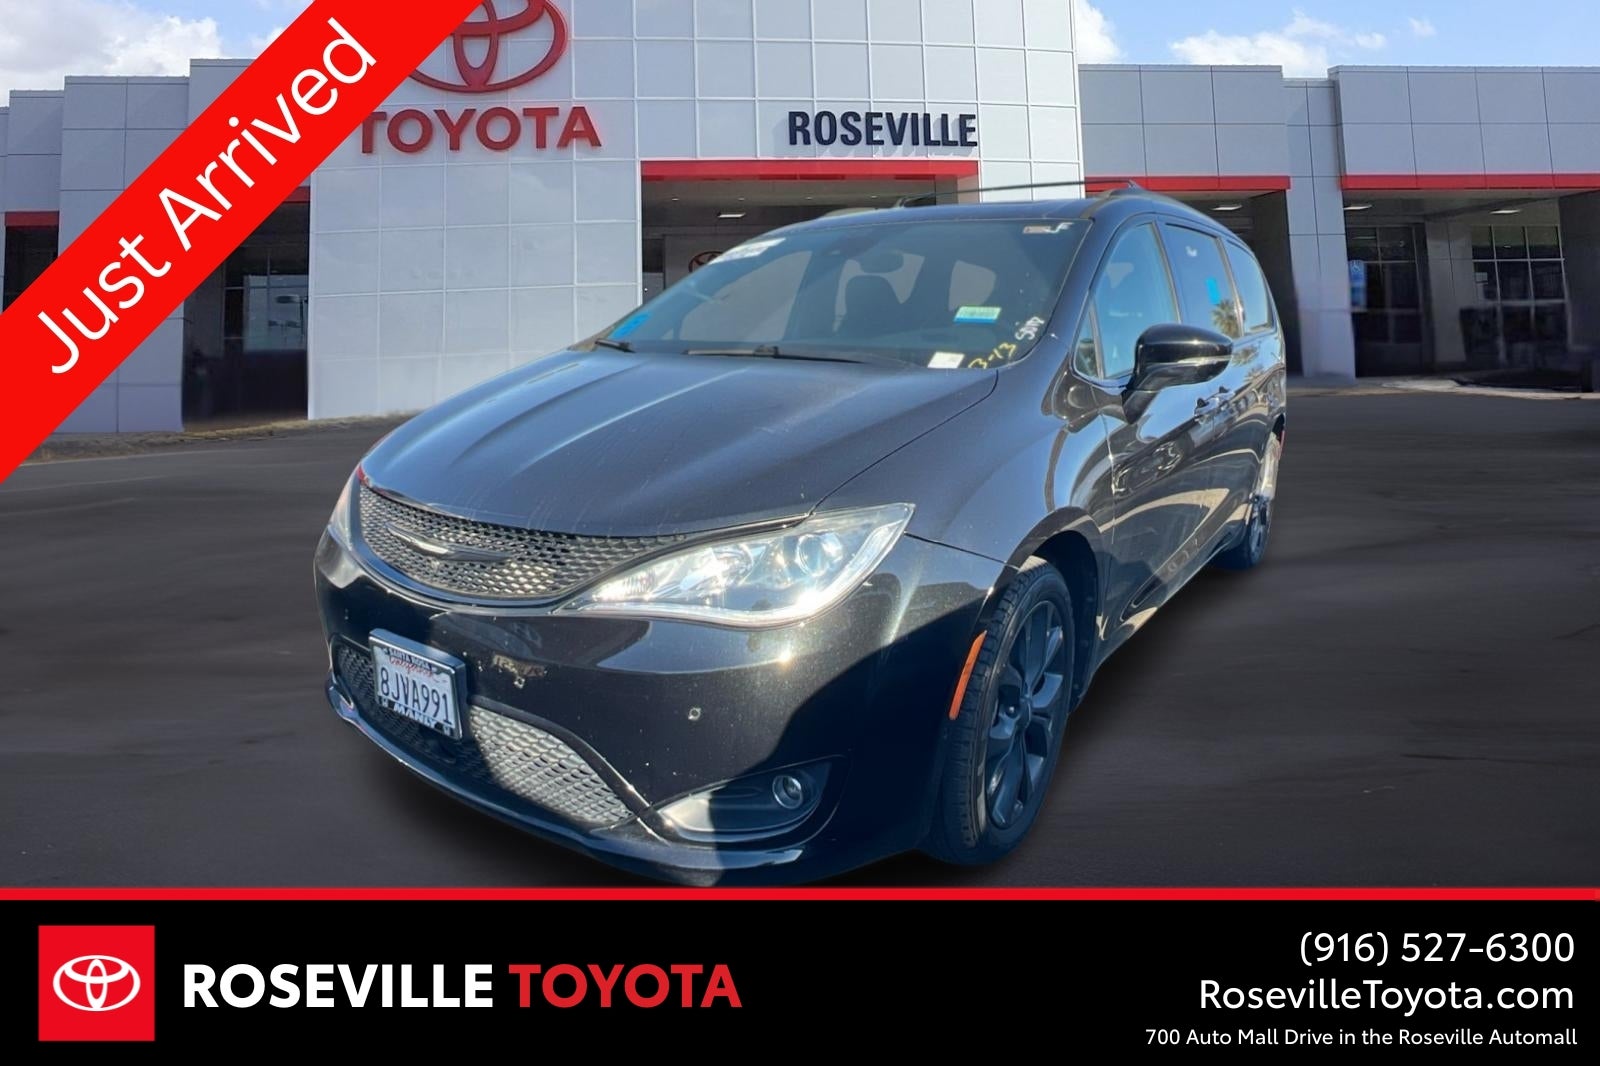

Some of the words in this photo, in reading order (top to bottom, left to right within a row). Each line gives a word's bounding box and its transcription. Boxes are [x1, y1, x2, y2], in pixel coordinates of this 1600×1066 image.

[361, 106, 602, 154] TOYOTA
[788, 110, 978, 147] ROSEVILLE
[380, 667, 452, 726] 8JVA991
